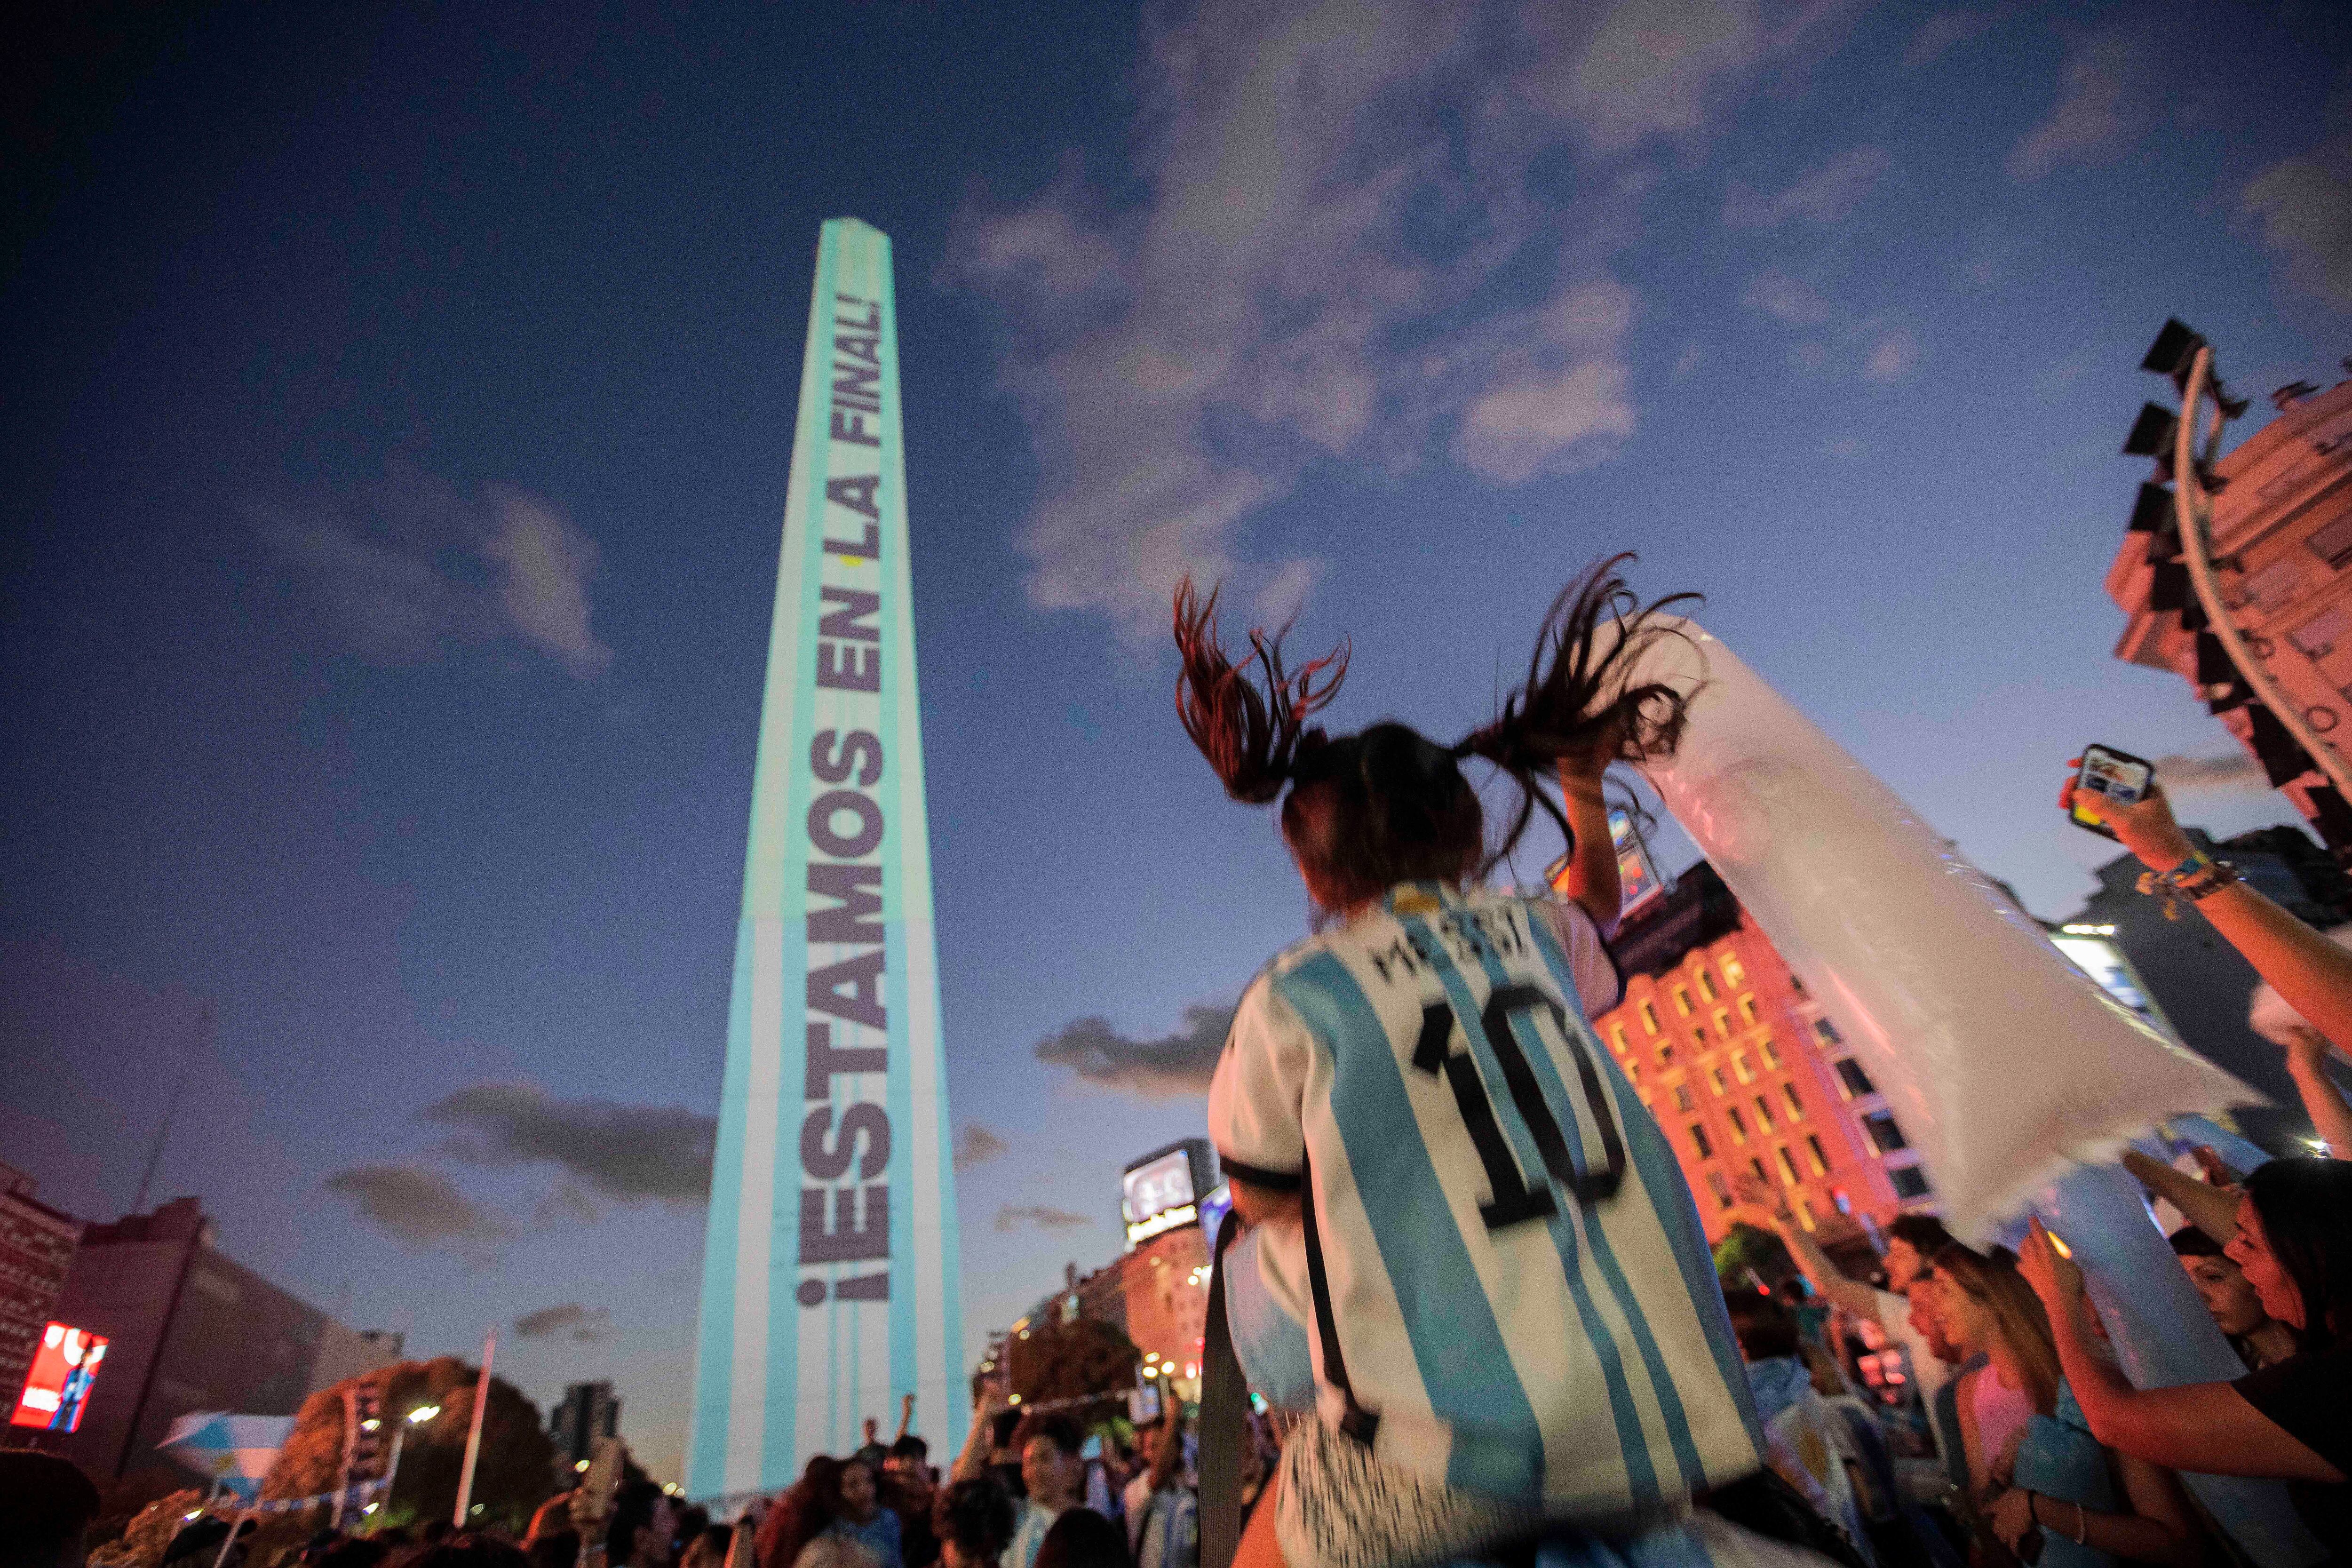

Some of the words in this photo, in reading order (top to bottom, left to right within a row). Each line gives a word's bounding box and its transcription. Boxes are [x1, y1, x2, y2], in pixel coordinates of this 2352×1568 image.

[828, 292, 882, 447] FINAL!
[822, 472, 880, 560] LA
[816, 584, 881, 693] EN
[795, 728, 891, 1307] ¡ESTAMOS
[1413, 985, 1628, 1230] 10
